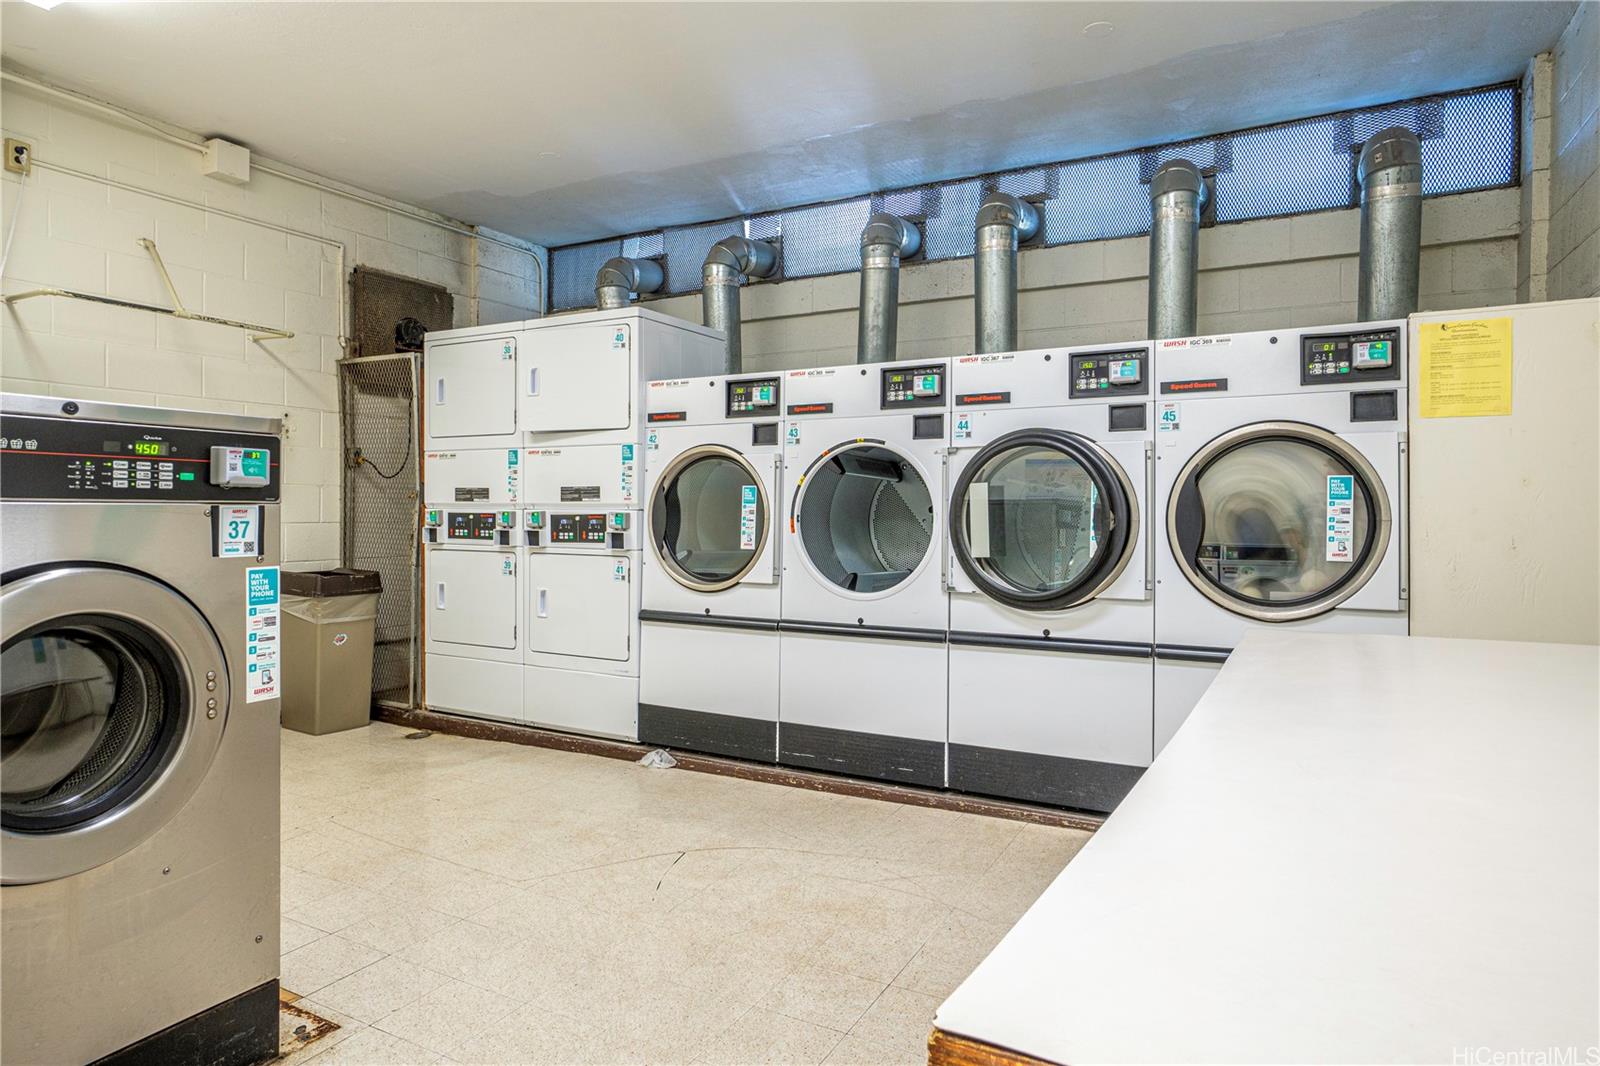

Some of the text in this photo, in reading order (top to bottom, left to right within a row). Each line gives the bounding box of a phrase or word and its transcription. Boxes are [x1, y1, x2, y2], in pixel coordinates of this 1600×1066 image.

[615, 333, 624, 342] 40
[1163, 410, 1176, 422] 45
[958, 421, 969, 430] 44
[788, 428, 798, 437] 43
[649, 435, 657, 443] 42
[136, 444, 159, 455] 450
[228, 520, 250, 539] 37
[251, 590, 274, 598] PHONE
